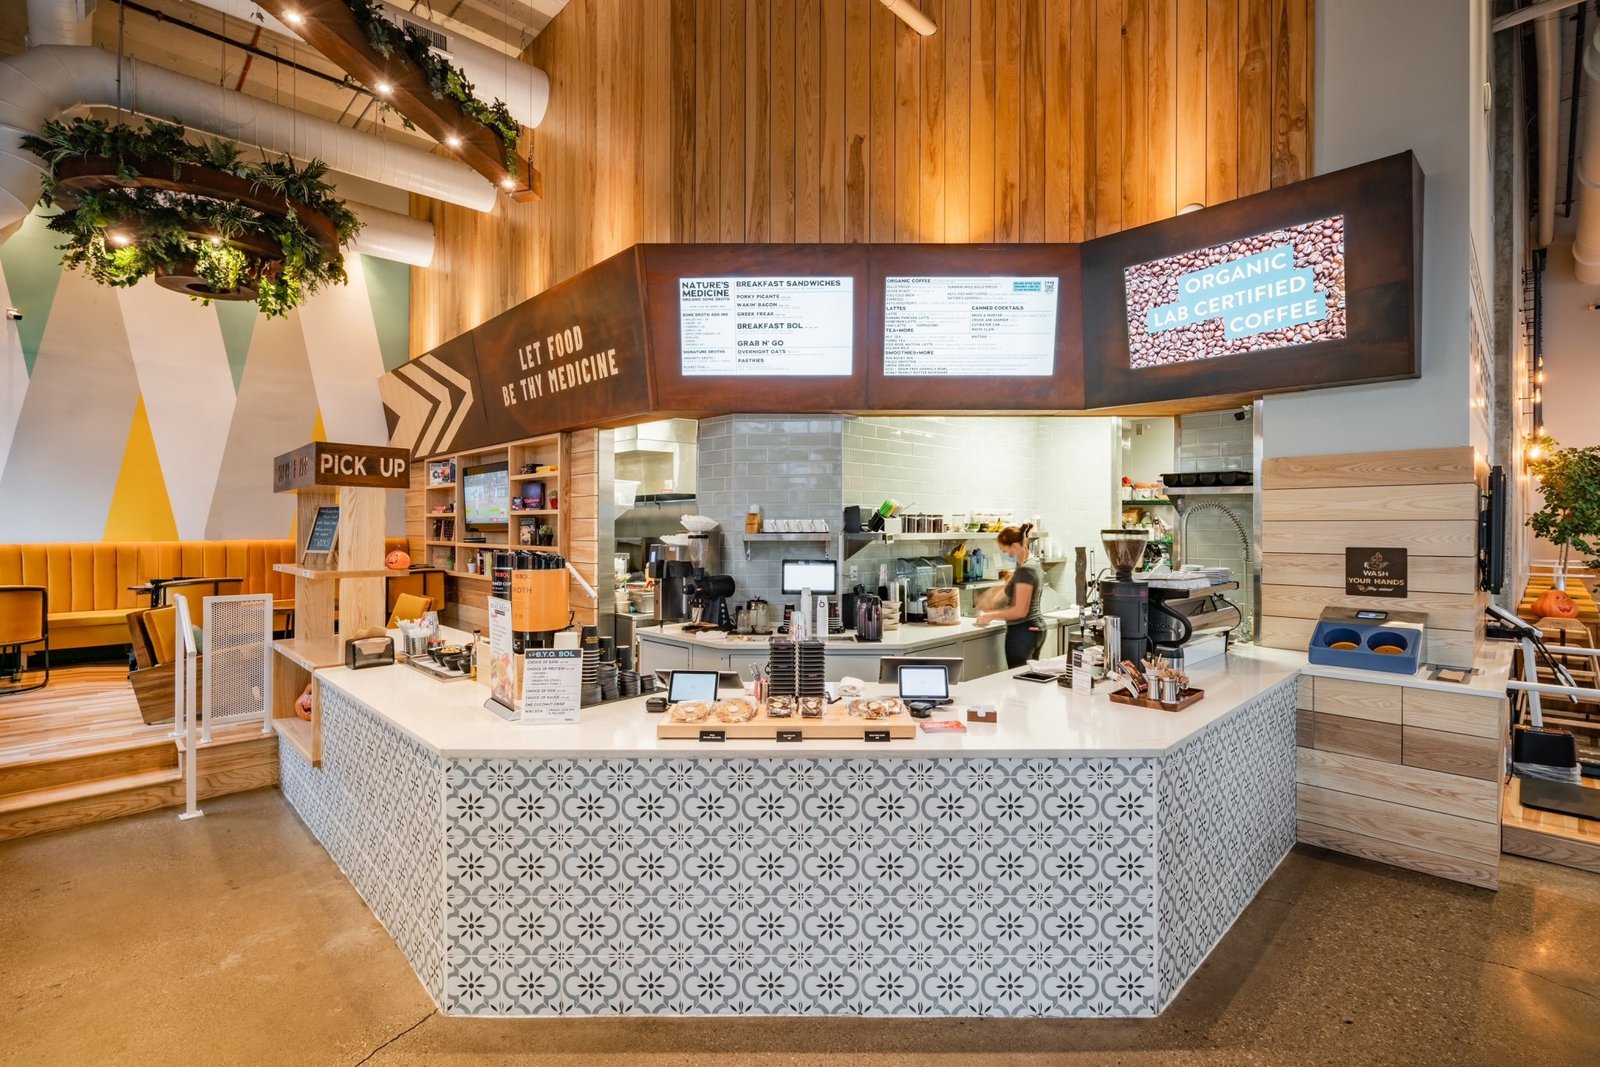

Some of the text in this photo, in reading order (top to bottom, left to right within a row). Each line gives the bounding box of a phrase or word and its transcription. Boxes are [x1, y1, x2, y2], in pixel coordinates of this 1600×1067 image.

[682, 281, 730, 289] NATURE'S
[1184, 252, 1286, 294] ORGANIC
[1153, 276, 1306, 327] LAB CERTIFIED
[1229, 298, 1318, 333] COFFEE
[518, 326, 583, 370] LET FOOD
[502, 348, 618, 406] BE THY MEDICINE
[320, 454, 366, 476] PICK
[380, 457, 406, 478] UP
